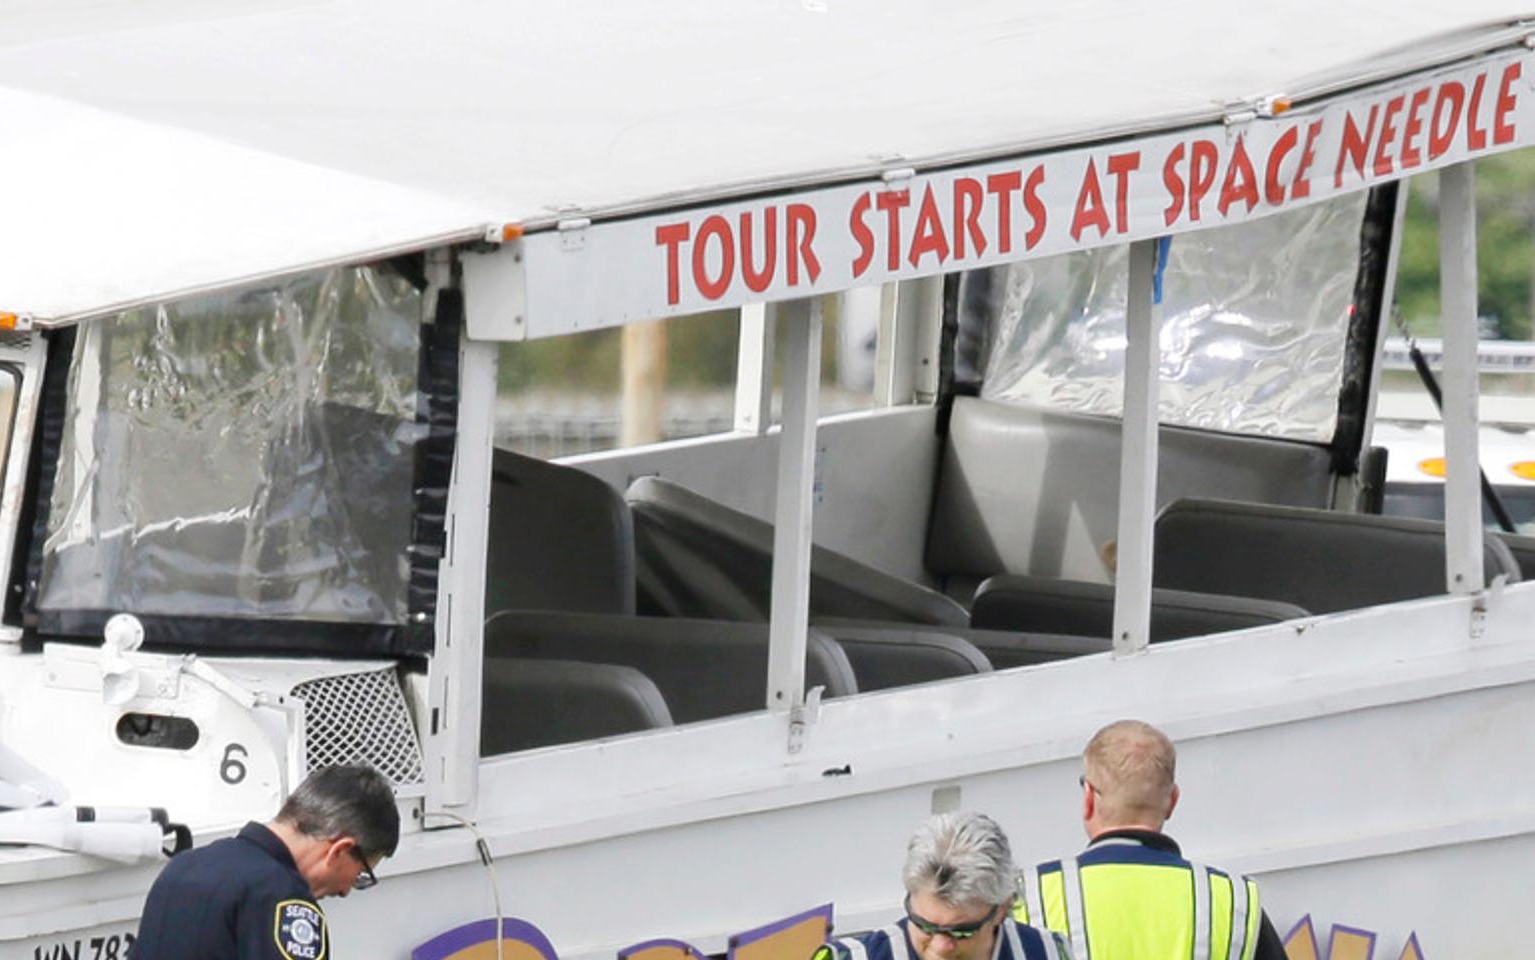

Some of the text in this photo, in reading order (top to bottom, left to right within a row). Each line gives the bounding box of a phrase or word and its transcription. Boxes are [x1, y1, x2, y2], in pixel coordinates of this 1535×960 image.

[655, 62, 1523, 306] TOUR STARTS AT SPACE NEEDLE
[220, 743, 246, 784] 6
[286, 940, 316, 959] POLICE
